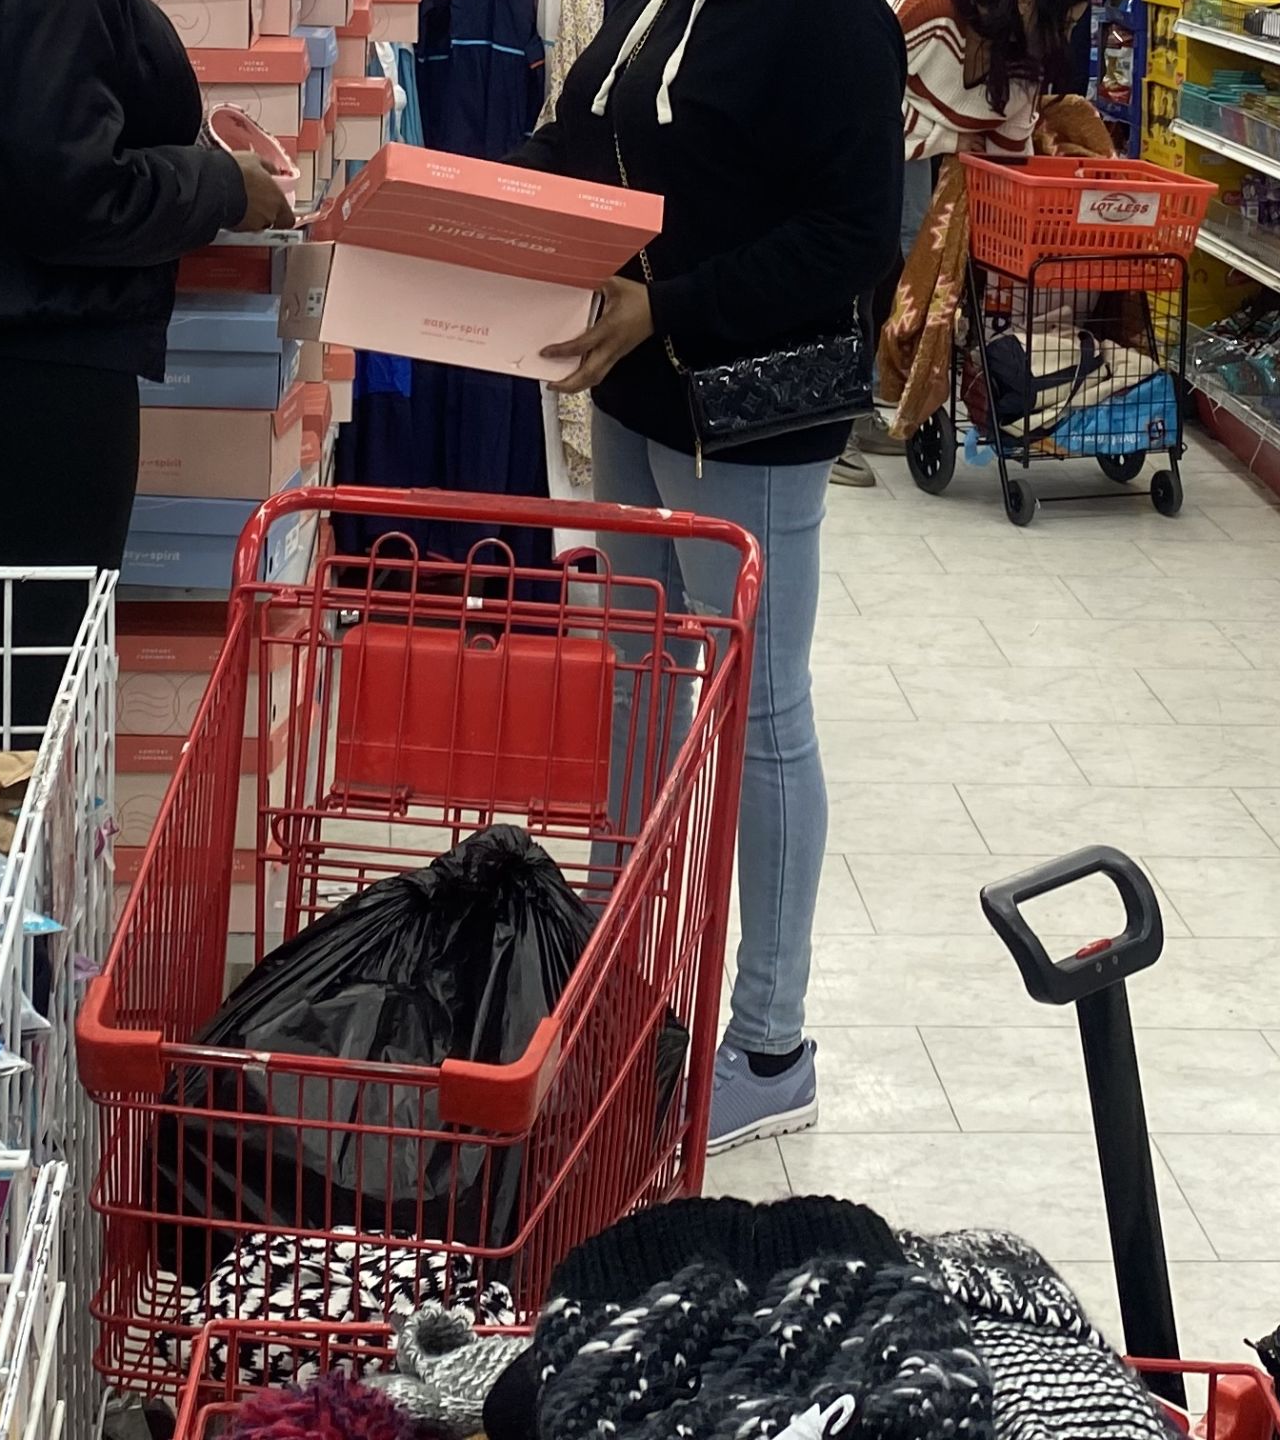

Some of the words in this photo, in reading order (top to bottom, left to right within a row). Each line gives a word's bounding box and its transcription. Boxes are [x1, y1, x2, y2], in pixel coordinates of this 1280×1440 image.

[1090, 202, 1150, 213] LOT-LESS
[428, 223, 493, 240] spirit
[510, 237, 557, 254] easy
[423, 318, 451, 331] easy
[460, 323, 489, 336] spirit
[150, 549, 180, 561] spirit
